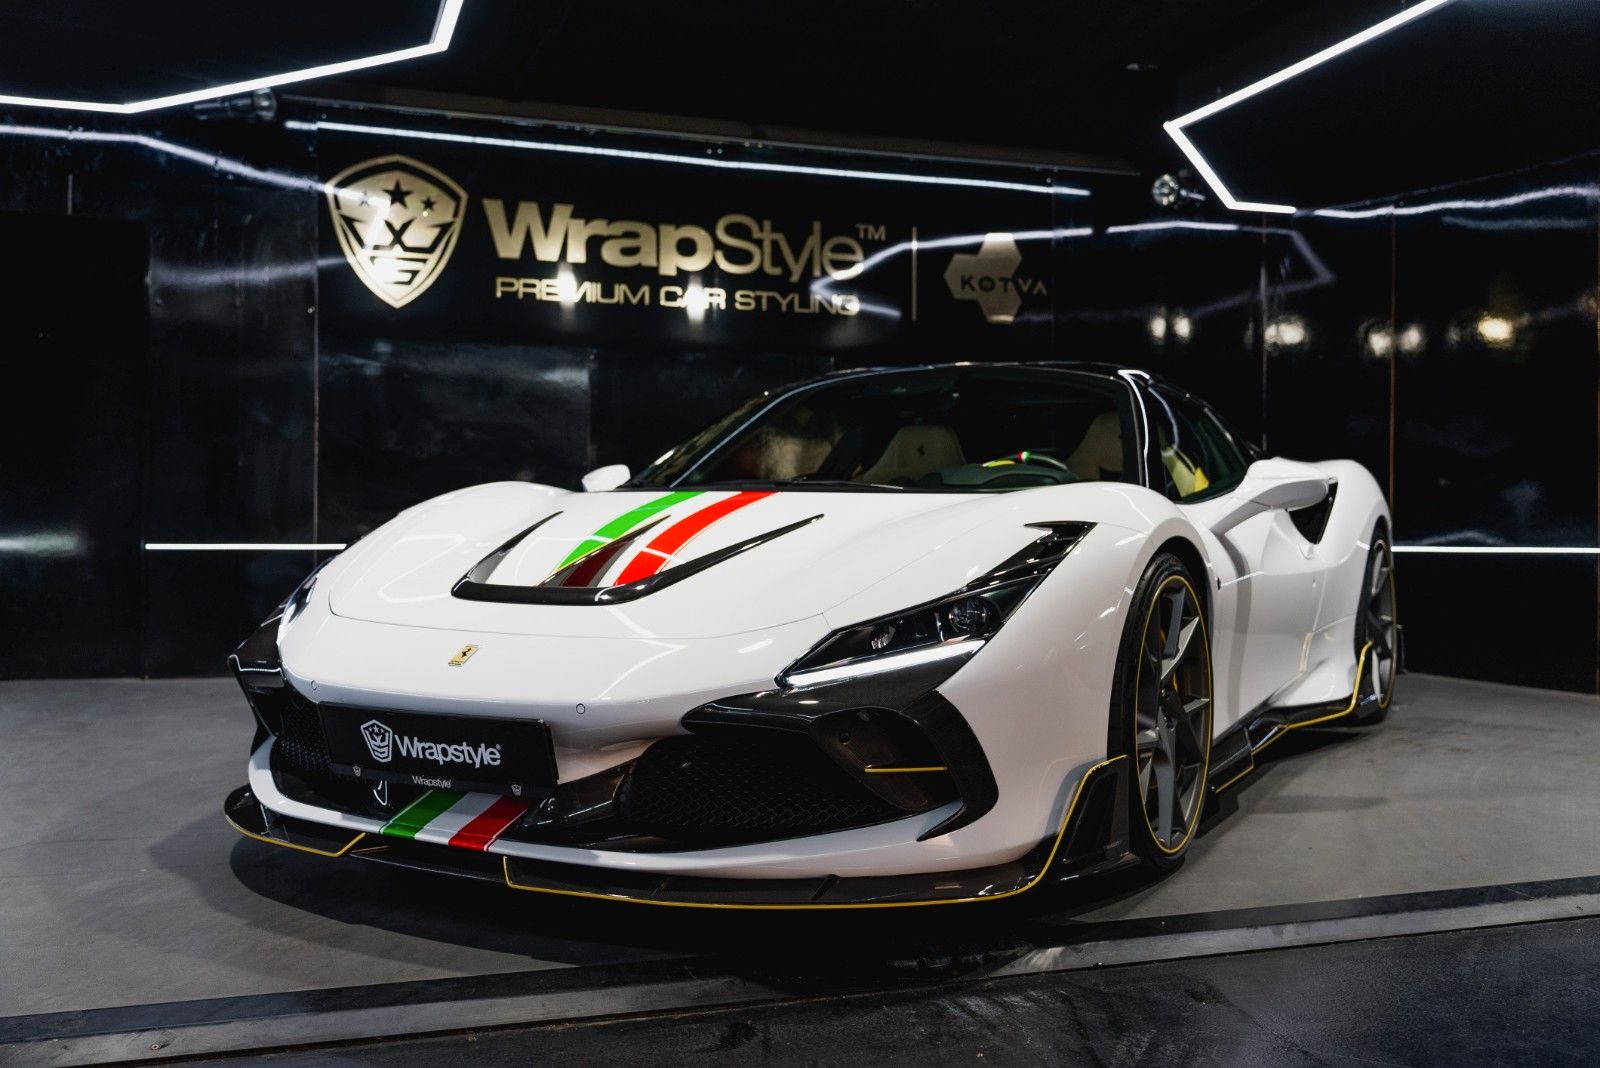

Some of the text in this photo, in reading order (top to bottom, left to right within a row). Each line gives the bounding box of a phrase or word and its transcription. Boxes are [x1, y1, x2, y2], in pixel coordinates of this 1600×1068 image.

[482, 199, 866, 281] WrapStyle
[735, 289, 860, 316] STYLING
[411, 775, 452, 788] Wrapstyle
